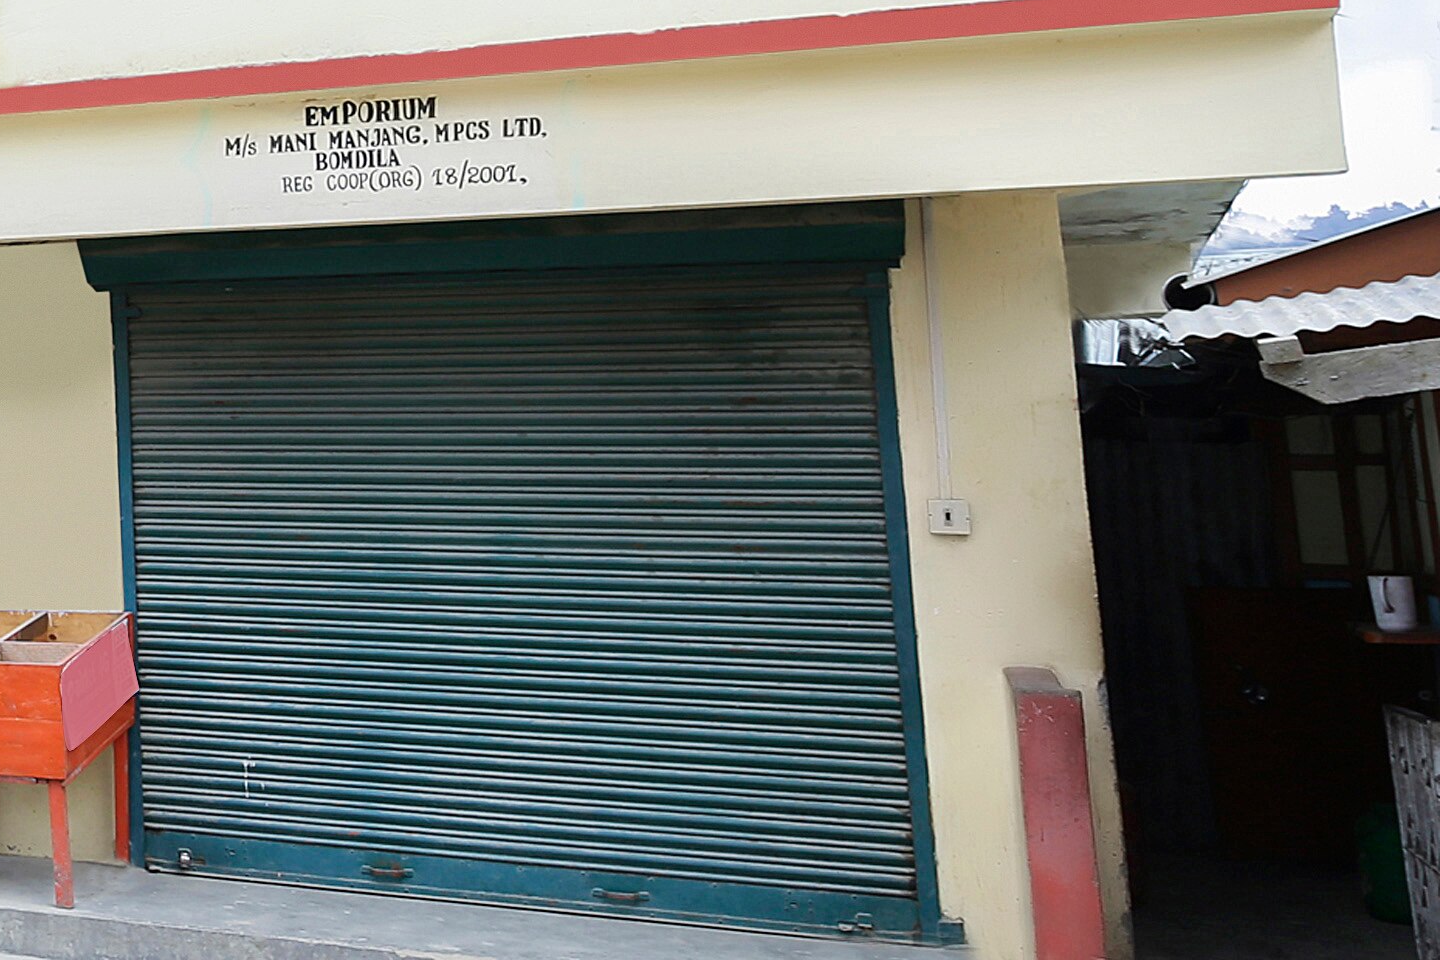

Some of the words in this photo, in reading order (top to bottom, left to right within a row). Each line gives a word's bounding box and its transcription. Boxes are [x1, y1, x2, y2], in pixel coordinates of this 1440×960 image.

[305, 96, 438, 127] EMPORIUM
[224, 132, 257, 158] M/s
[269, 131, 317, 154] MANI
[435, 119, 490, 143] MPCS
[315, 147, 402, 171] BOMDILA
[281, 175, 313, 193] REG
[327, 164, 422, 192] COOP(ORG)
